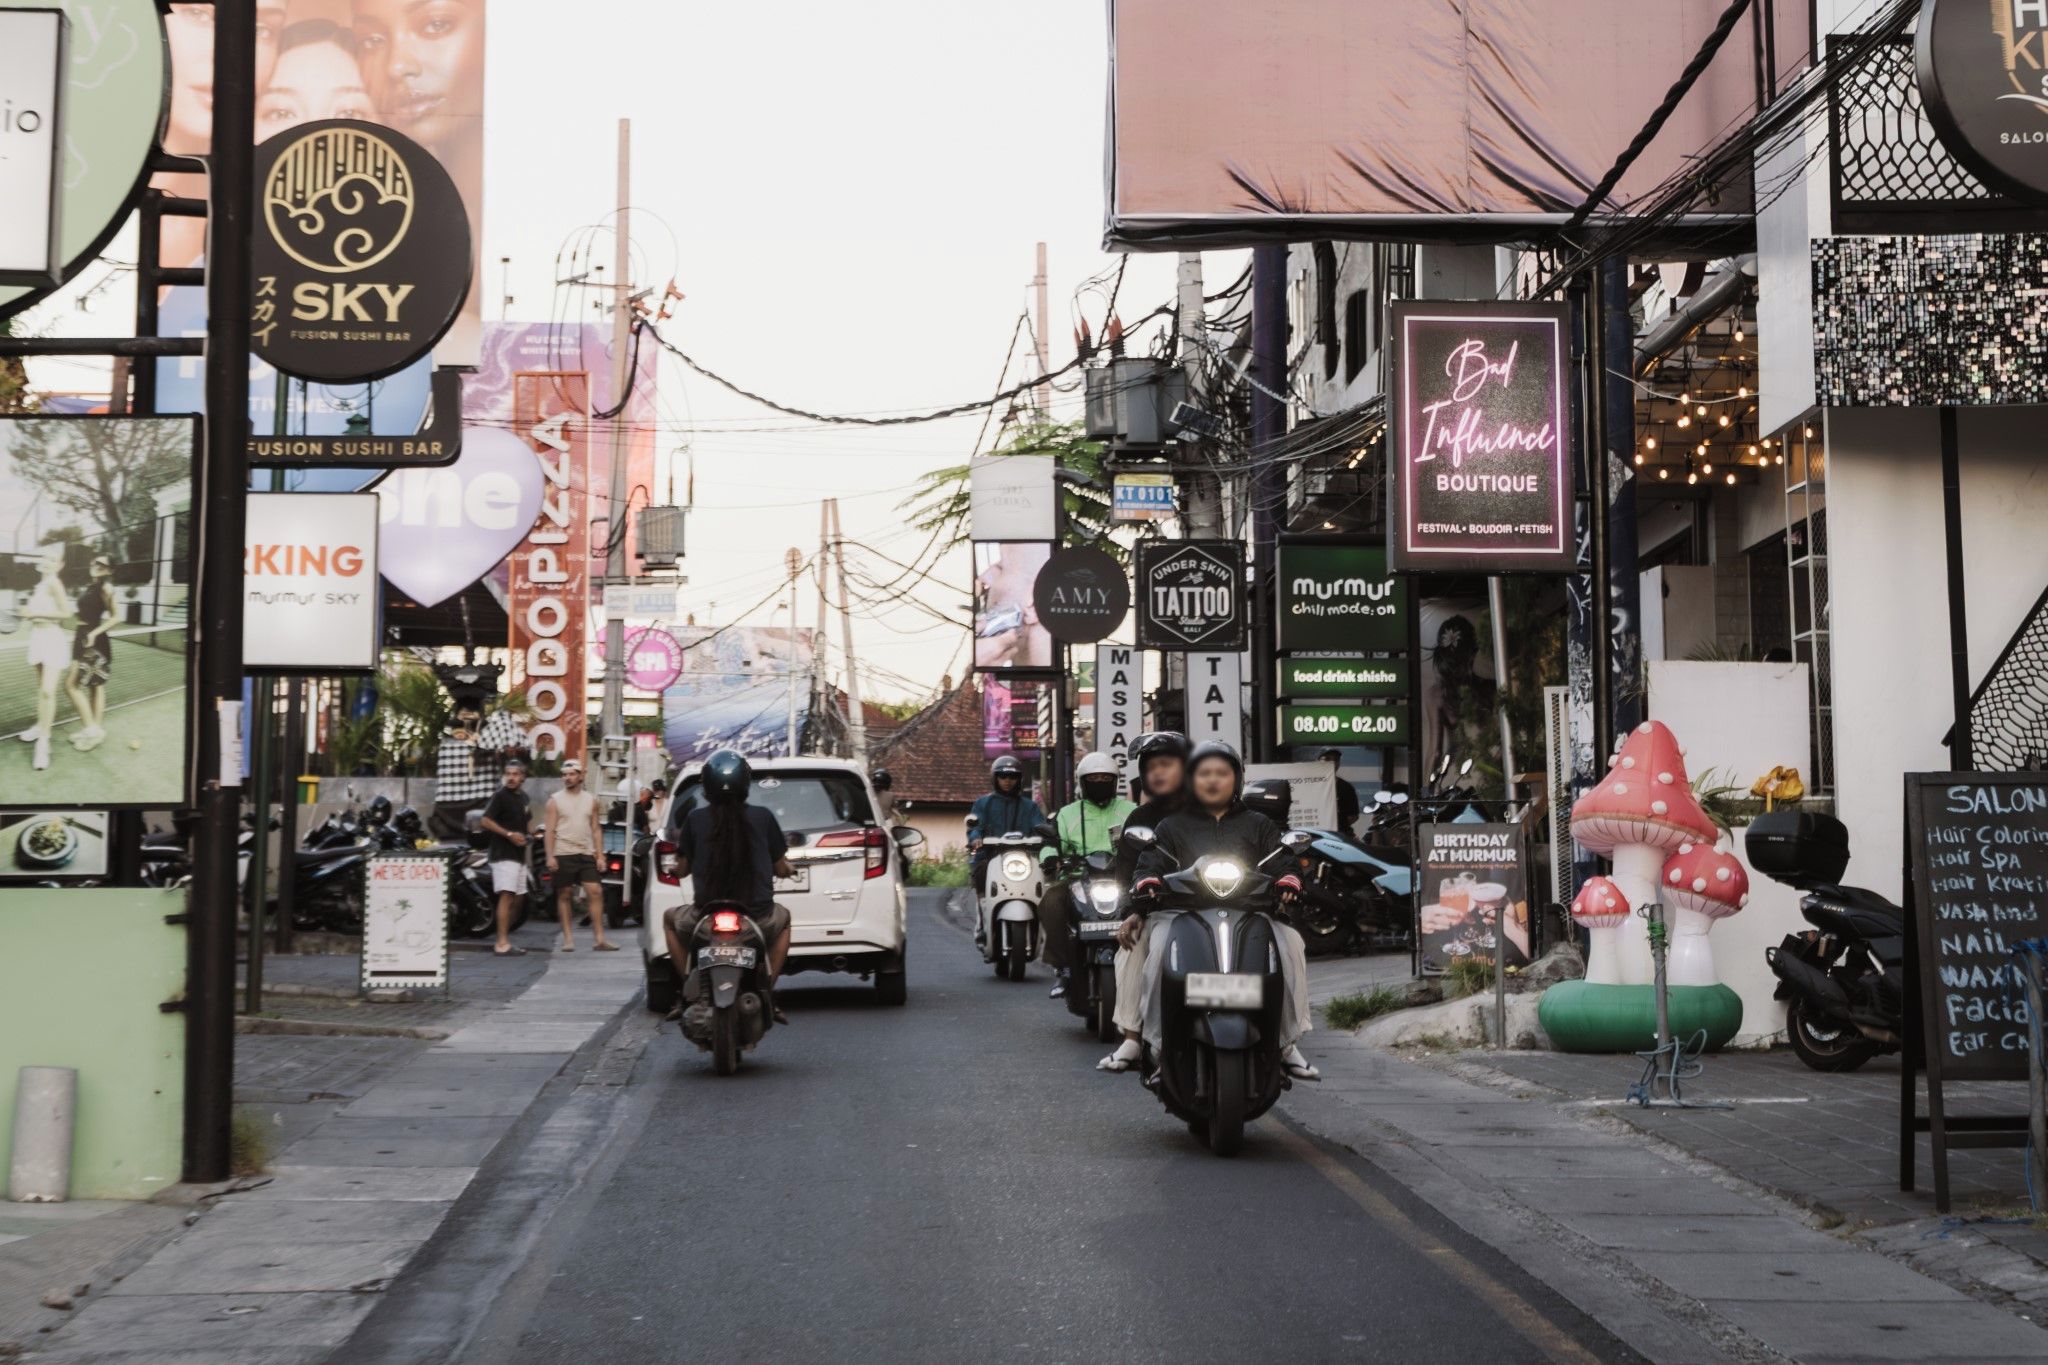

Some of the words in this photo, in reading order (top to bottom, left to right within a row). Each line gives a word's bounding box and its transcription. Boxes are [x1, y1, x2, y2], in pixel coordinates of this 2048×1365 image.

[252, 276, 278, 347] スカイ
[291, 282, 415, 322] SKY
[290, 331, 338, 340] FUSION
[343, 331, 381, 341] SUSHI
[385, 332, 411, 341] BAR
[1446, 339, 1517, 402] Bad
[1415, 400, 1556, 467] Influence
[331, 442, 394, 456] SUSHI
[402, 441, 443, 456] BAR
[1436, 474, 1538, 493] BOUTIQUE
[1138, 487, 1173, 501] 0101
[1469, 524, 1513, 534] BOUDOIR
[244, 545, 364, 577] KING
[1154, 560, 1198, 580] UNDER
[1199, 561, 1230, 581] SKIN
[248, 591, 316, 605] murmur
[325, 592, 361, 605] SKY
[1051, 586, 1112, 605] AMY
[1293, 578, 1395, 600] murmur
[1153, 586, 1230, 617] TATTOO
[1292, 602, 1325, 616] chill
[1376, 604, 1396, 615] on
[1183, 626, 1202, 634] BALI
[633, 652, 668, 672] SPA
[1294, 669, 1323, 683] food
[1323, 669, 1357, 683] drink
[1357, 670, 1397, 683] shisha
[1293, 716, 1340, 733] 08.00
[1352, 716, 1397, 733] 02.00
[1946, 785, 2047, 814] SALON
[1433, 833, 1510, 847] BIRTHDAY
[1927, 826, 1971, 845] Hair
[1427, 849, 1448, 862] AT
[1450, 849, 1517, 862] MURMUR
[1930, 849, 1971, 868] Hair
[410, 864, 440, 880] OPEN
[1931, 873, 1976, 893] Hair
